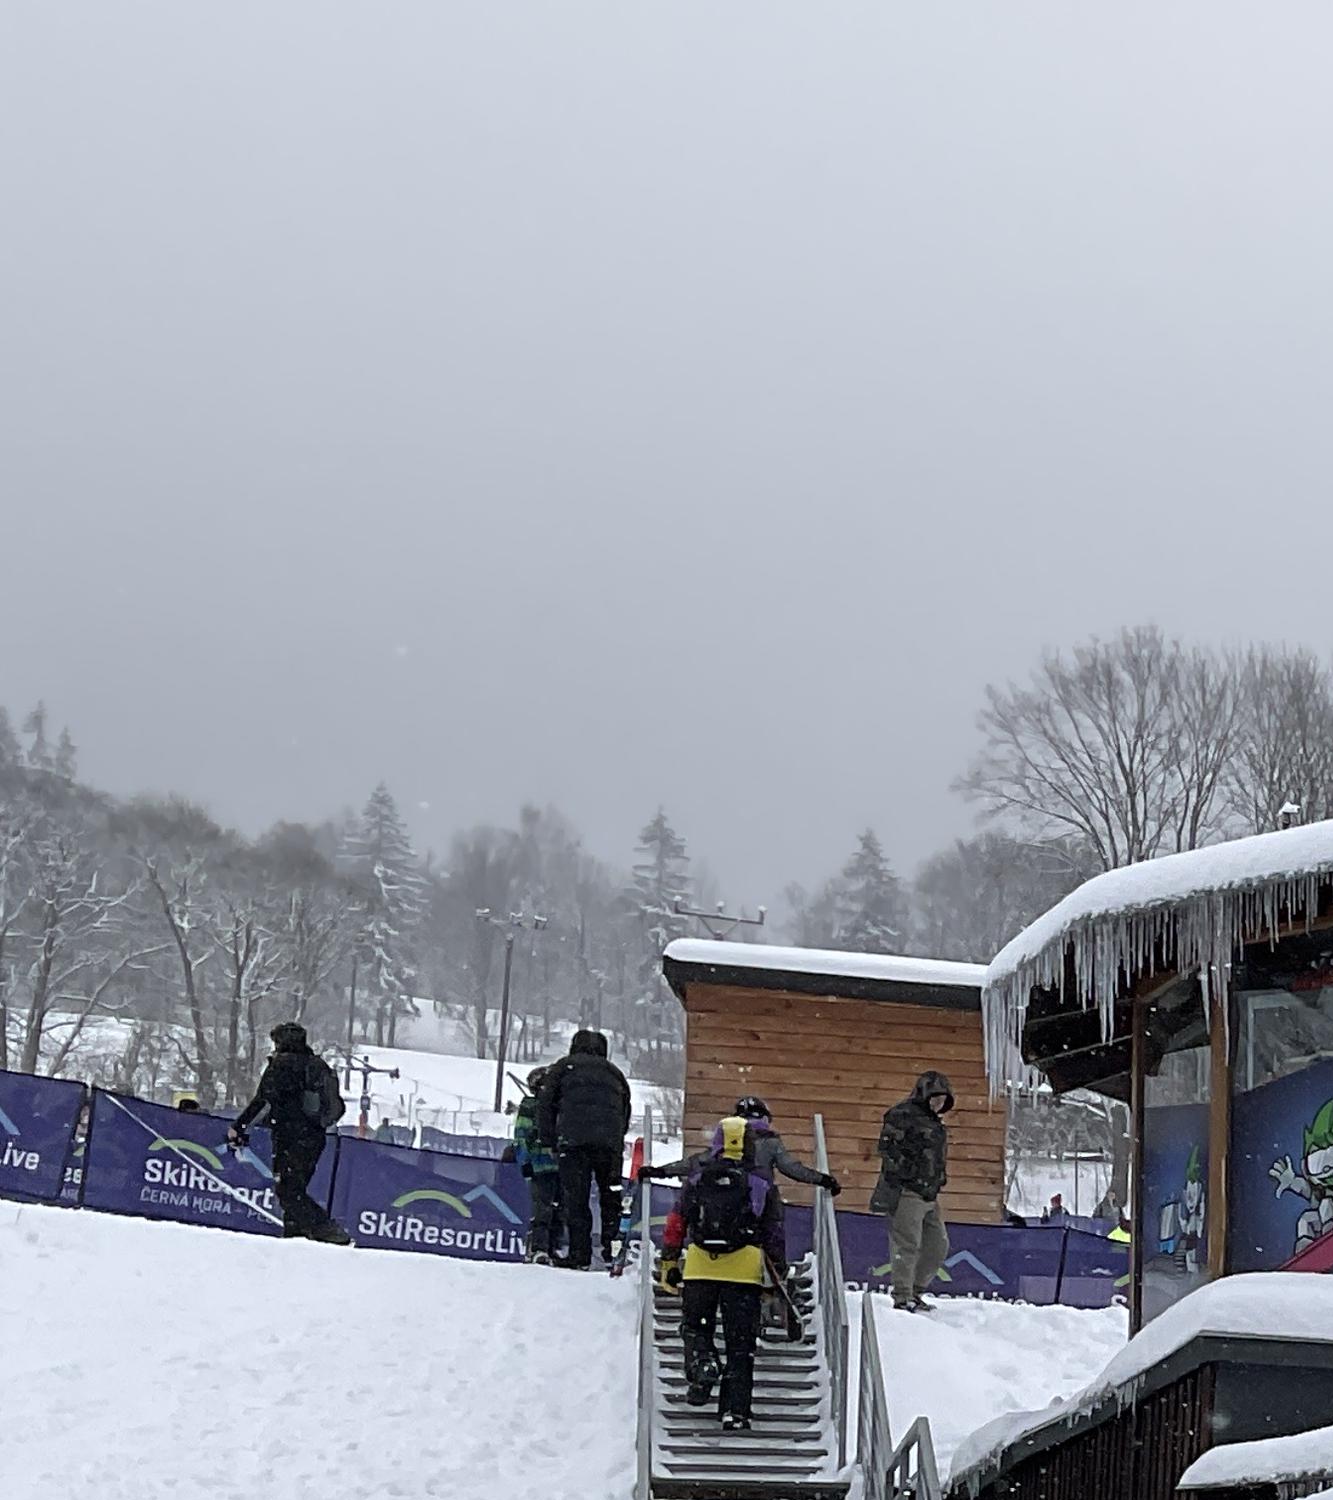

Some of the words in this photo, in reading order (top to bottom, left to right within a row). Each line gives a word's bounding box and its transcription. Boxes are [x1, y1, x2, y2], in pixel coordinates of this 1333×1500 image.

[0, 1141, 40, 1170] ive
[144, 1158, 274, 1209] SkiReort
[192, 1196, 231, 1214] HORA
